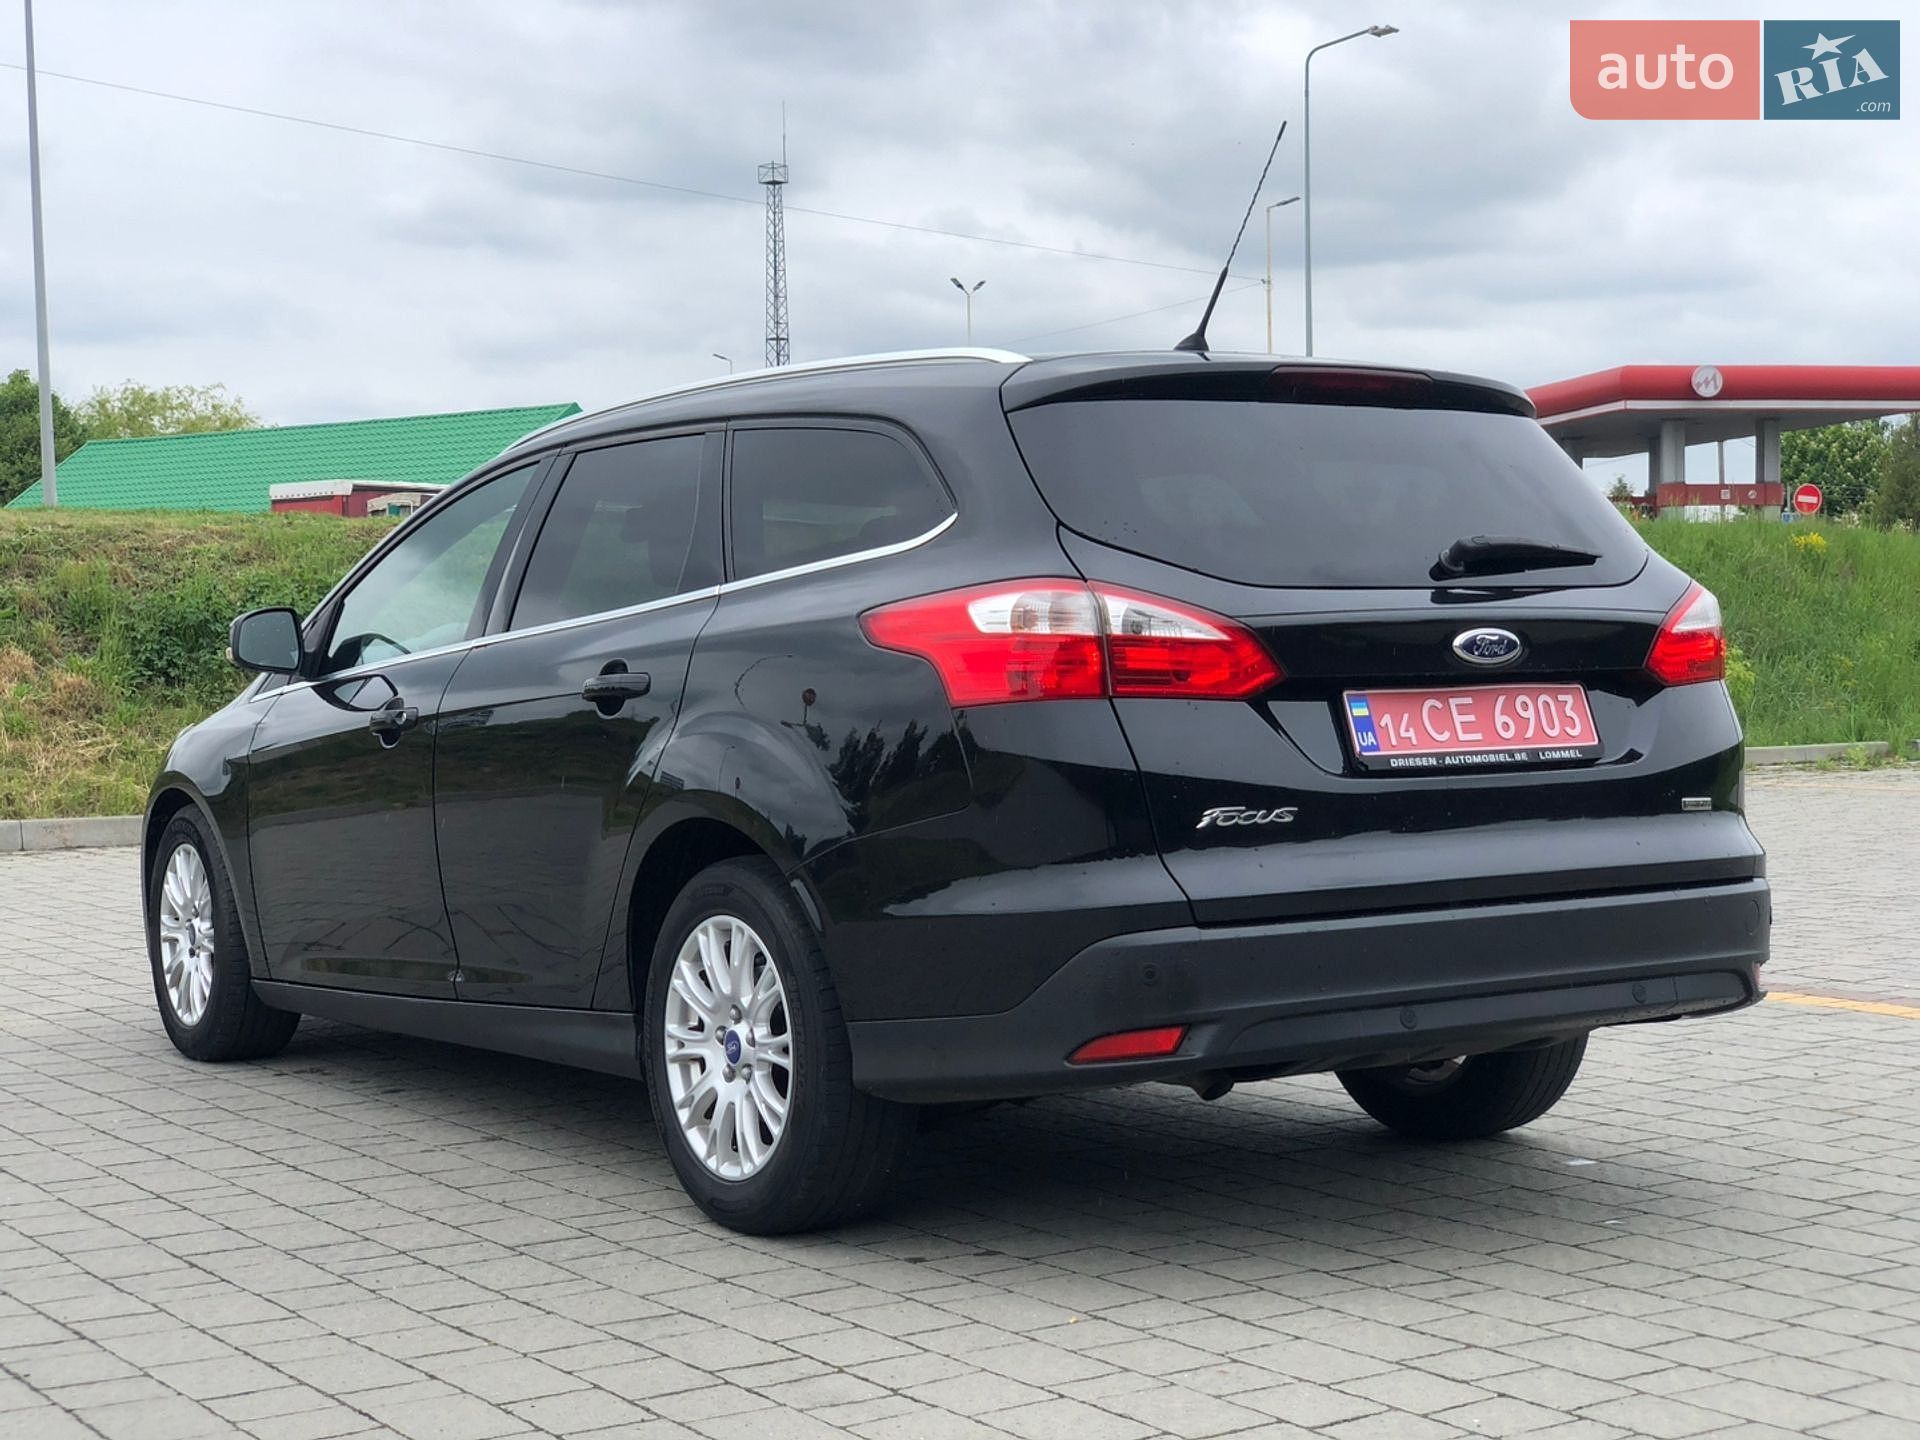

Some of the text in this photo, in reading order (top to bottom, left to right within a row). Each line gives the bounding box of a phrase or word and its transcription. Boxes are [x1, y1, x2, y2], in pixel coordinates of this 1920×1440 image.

[1473, 634, 1509, 656] Ford
[1379, 694, 1582, 746] 14 CE 6903
[1358, 732, 1377, 747] UA
[1390, 756, 1437, 768] DRIESEN
[1539, 748, 1583, 761] LOMMEL
